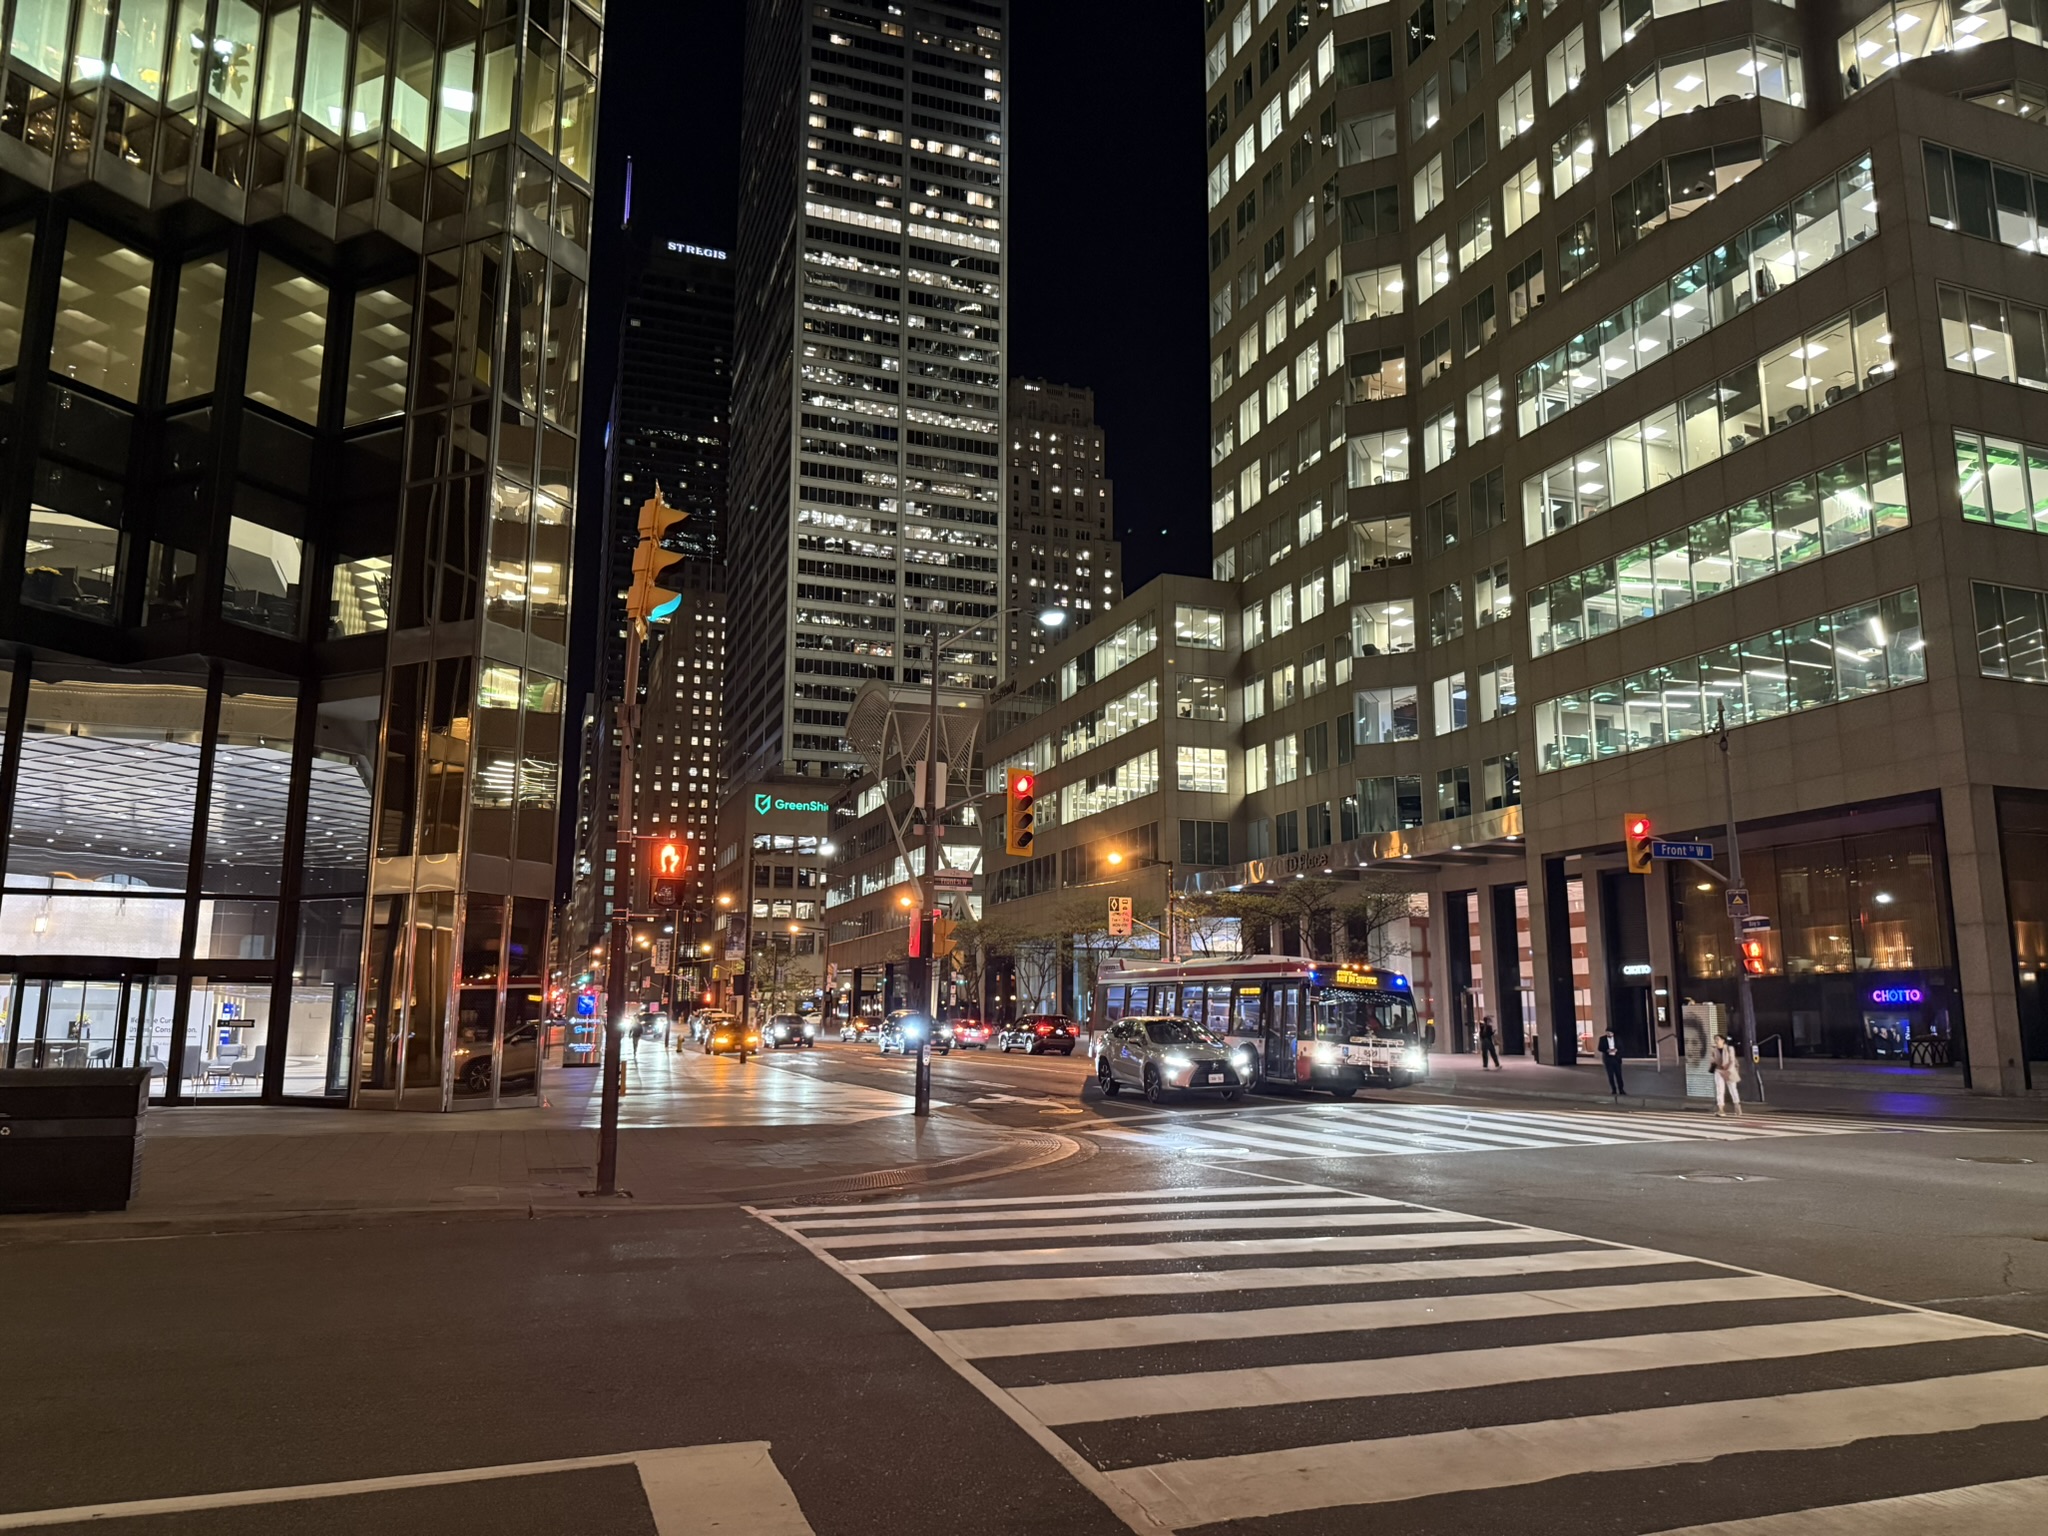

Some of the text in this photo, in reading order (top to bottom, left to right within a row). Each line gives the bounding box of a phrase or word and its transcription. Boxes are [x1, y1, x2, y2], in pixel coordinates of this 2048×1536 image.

[667, 241, 727, 260] ST REGIS
[1661, 844, 1687, 856] Front
[1696, 846, 1704, 857] W
[1300, 852, 1328, 871] Place
[1356, 976, 1378, 985] SERVICE
[1872, 989, 1921, 1003] CHOTTO
